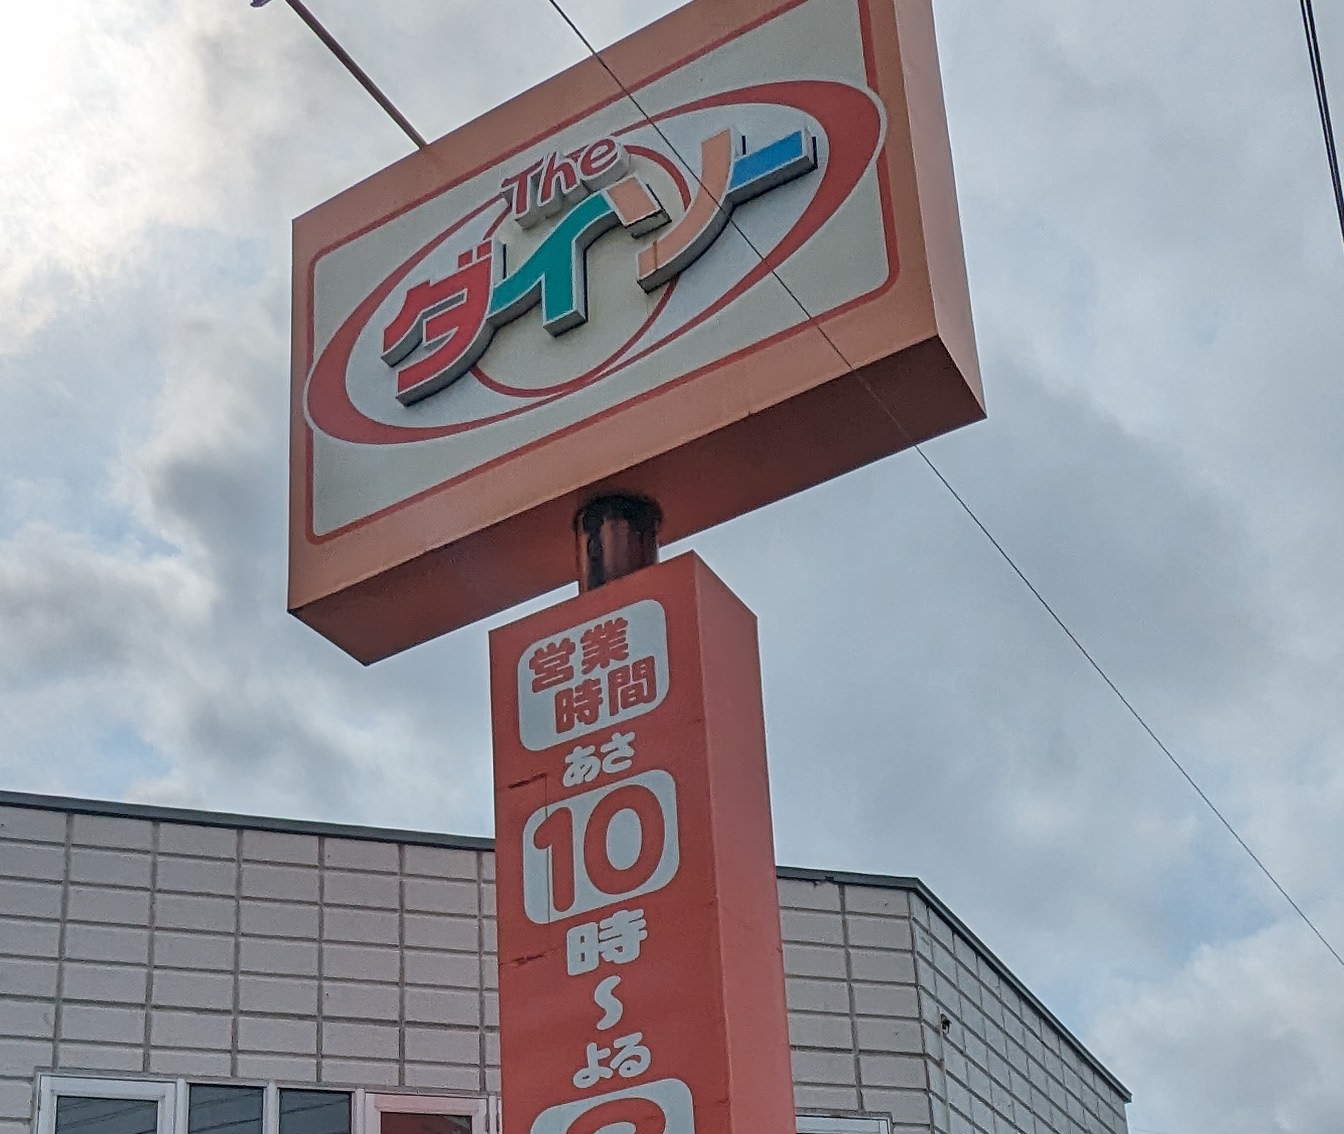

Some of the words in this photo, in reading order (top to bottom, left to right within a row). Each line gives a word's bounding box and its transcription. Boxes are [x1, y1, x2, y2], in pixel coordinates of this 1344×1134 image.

[504, 136, 622, 212] The
[381, 128, 816, 405] ダイソー
[528, 617, 631, 693] 営業
[554, 657, 658, 727] 時間
[562, 731, 637, 788] あさ
[532, 783, 666, 912] 10
[566, 908, 648, 977] 時
[572, 1033, 653, 1089] よる
